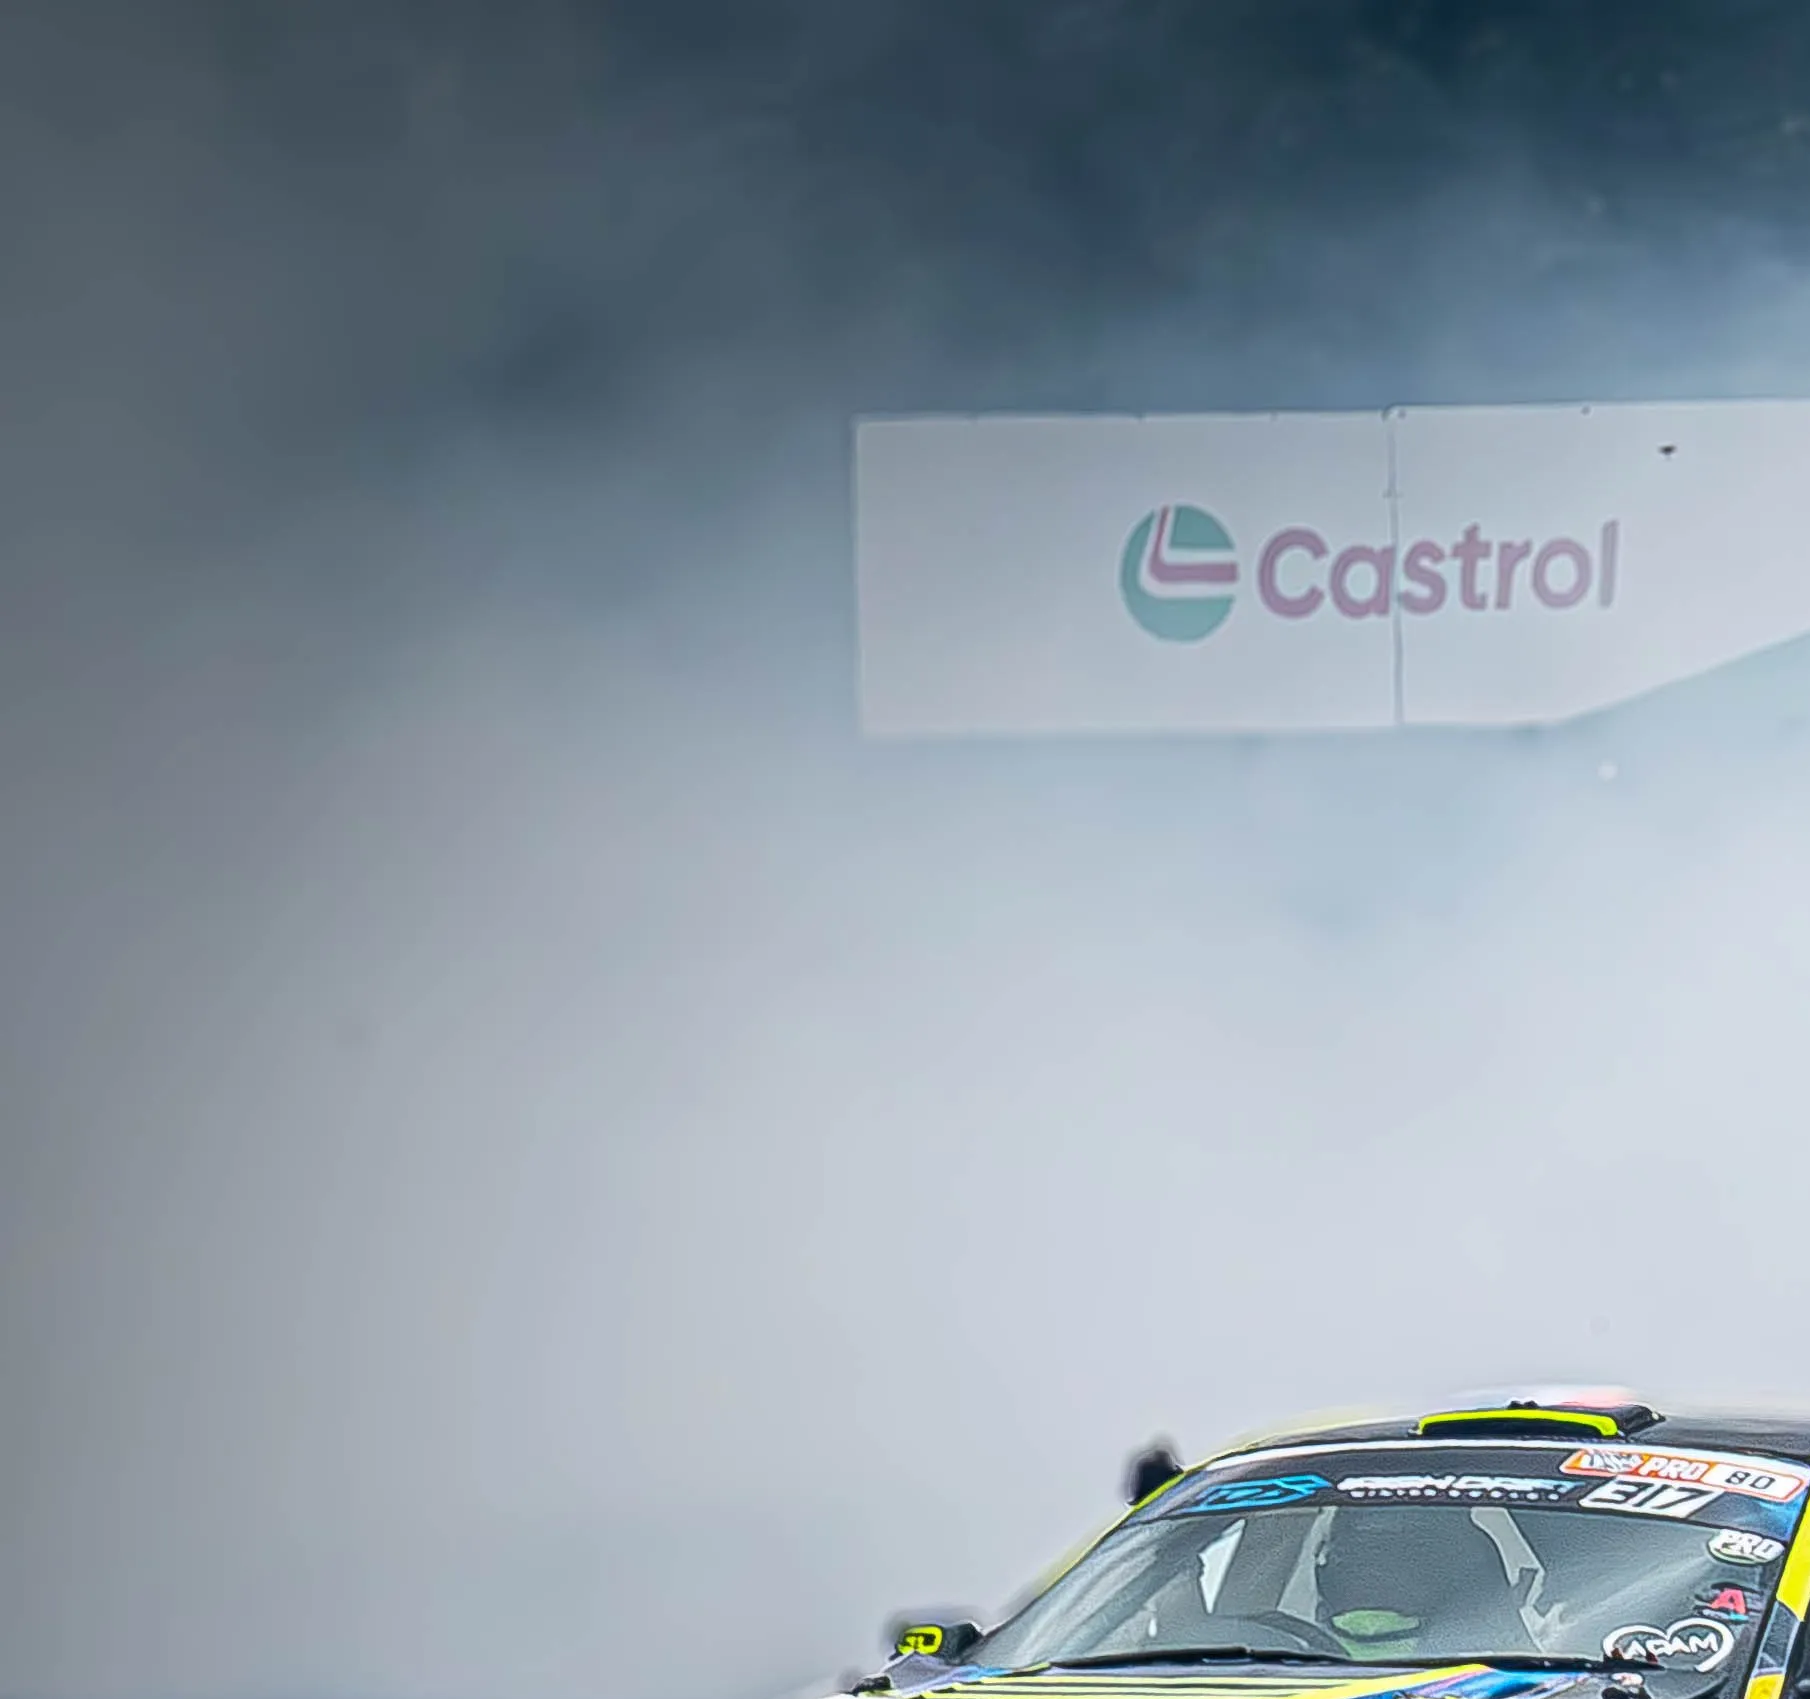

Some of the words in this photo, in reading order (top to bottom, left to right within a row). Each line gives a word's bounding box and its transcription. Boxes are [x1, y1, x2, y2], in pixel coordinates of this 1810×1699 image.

[1258, 520, 1620, 620] Castrol
[1638, 1456, 1711, 1481] PRO
[1724, 1470, 1777, 1490] 80
